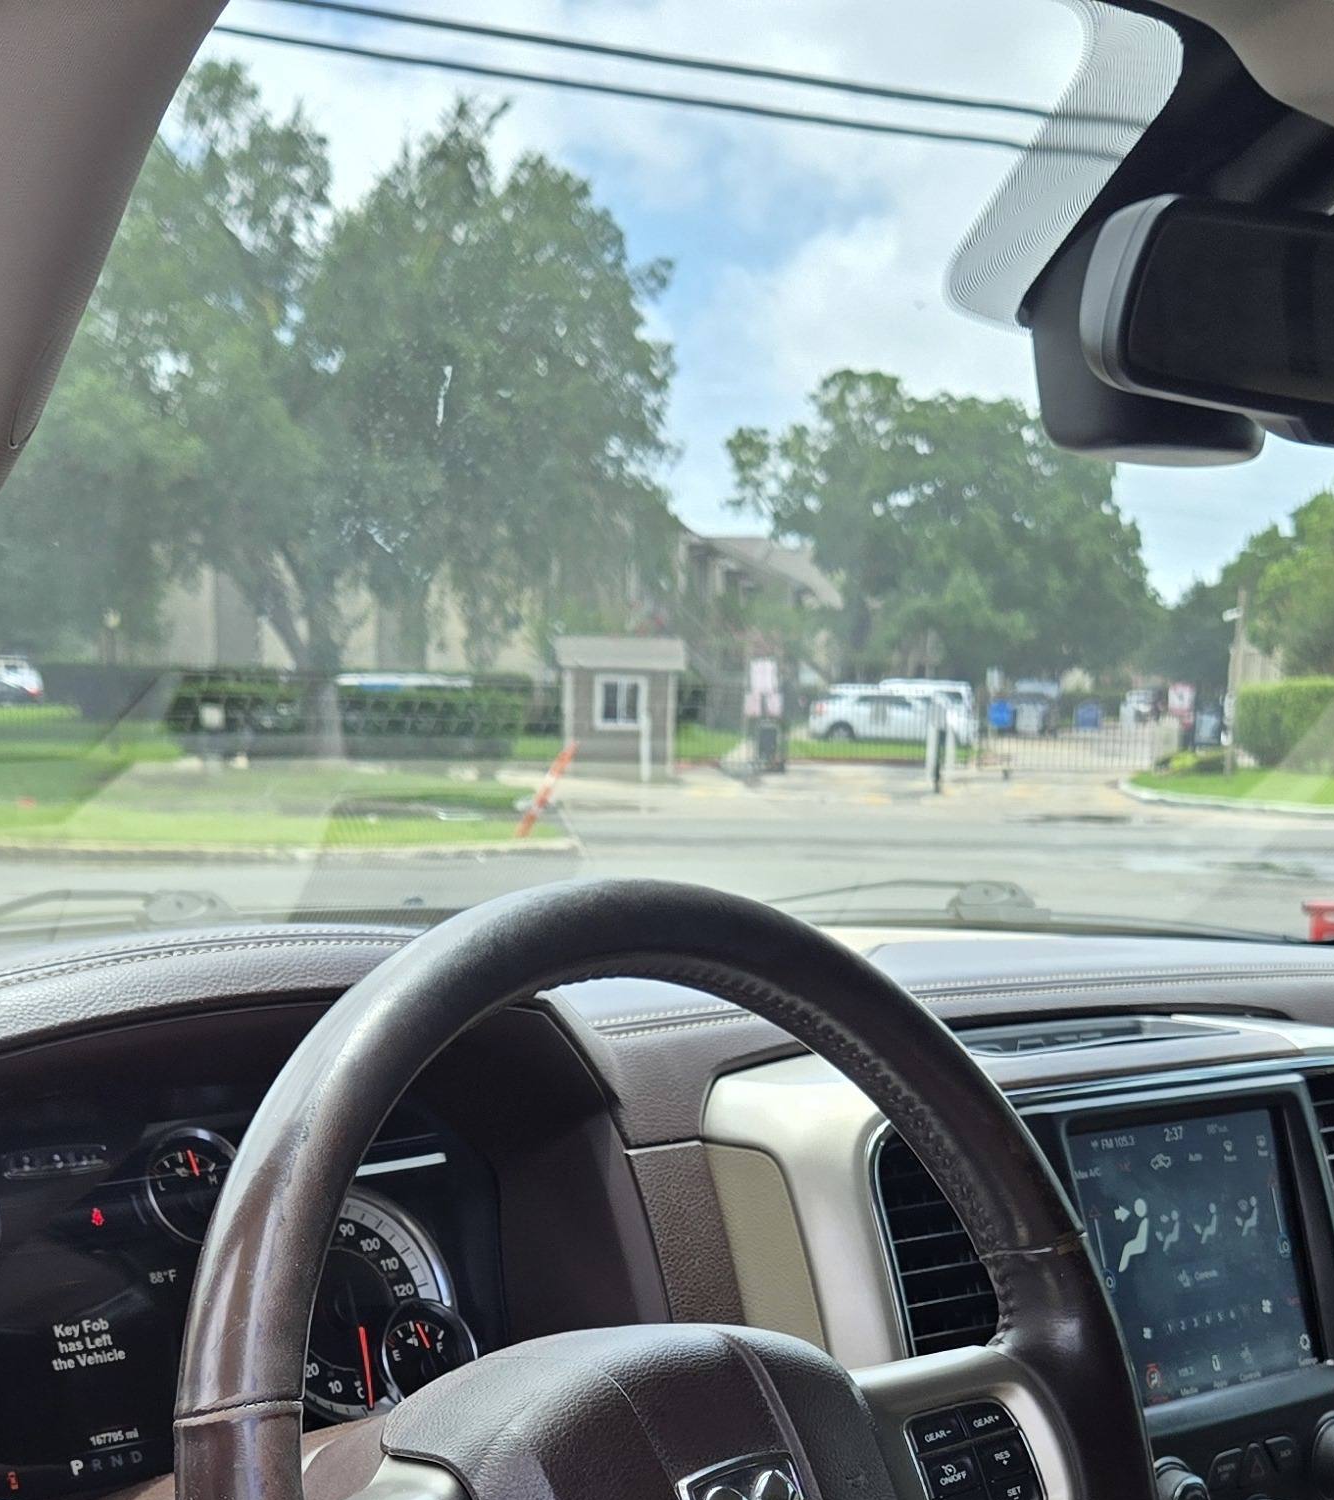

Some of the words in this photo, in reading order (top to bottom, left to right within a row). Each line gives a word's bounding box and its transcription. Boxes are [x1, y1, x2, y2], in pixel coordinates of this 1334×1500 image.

[1163, 1126, 1183, 1142] 2:37
[338, 1223, 355, 1237] 90
[360, 1237, 381, 1252] 100
[380, 1257, 399, 1272] 110
[393, 1282, 415, 1297] 120
[52, 1323, 79, 1338] Key
[81, 1318, 109, 1334] Fob
[58, 1340, 84, 1354] has
[85, 1334, 113, 1350] Left
[52, 1357, 75, 1371] the
[76, 1348, 126, 1367] Vehicle
[305, 1362, 320, 1379] 20
[328, 1380, 343, 1395] 10
[70, 1459, 84, 1476] P
[91, 1458, 103, 1472] R
[110, 1454, 124, 1468] N
[131, 1450, 143, 1463] D
[994, 1450, 1010, 1462] RES
[939, 1470, 967, 1486] ON/OFF
[1007, 1486, 1021, 1498] SET
